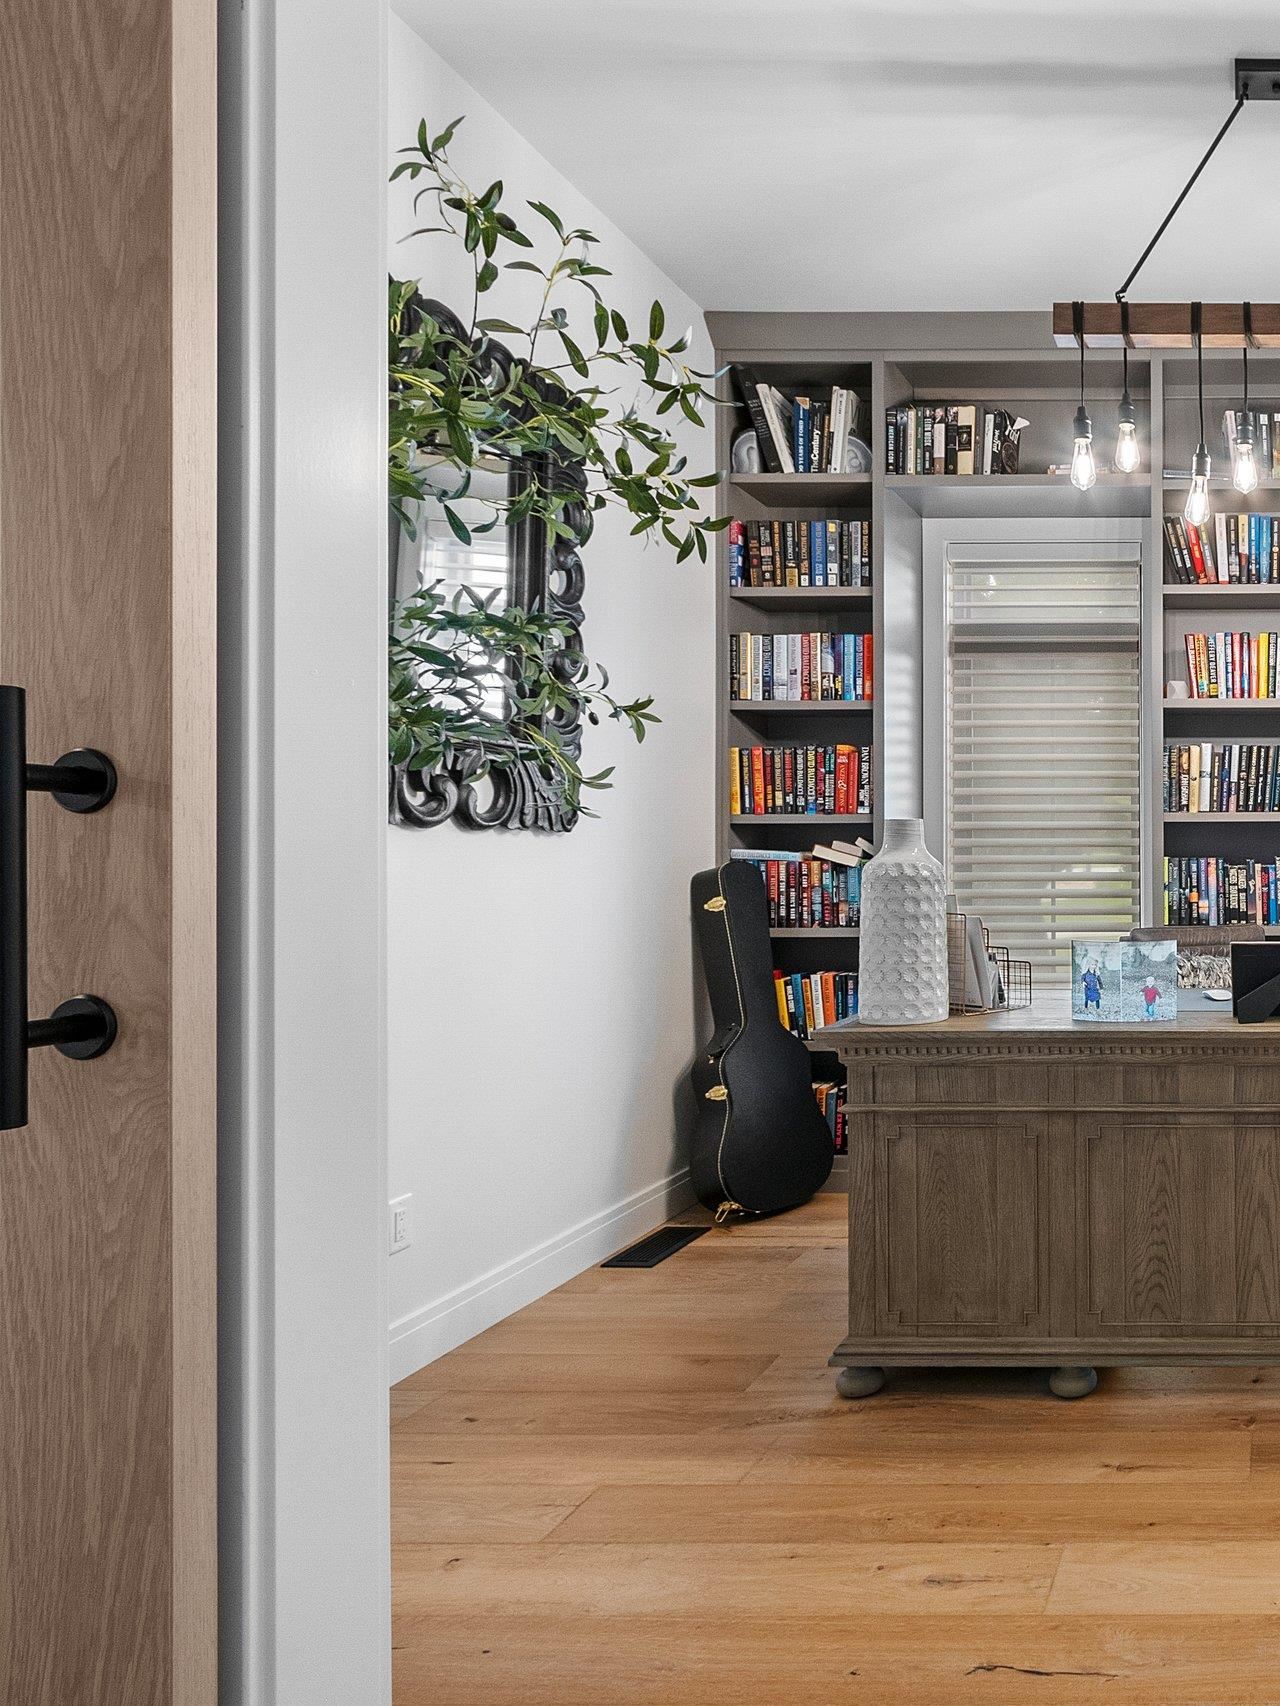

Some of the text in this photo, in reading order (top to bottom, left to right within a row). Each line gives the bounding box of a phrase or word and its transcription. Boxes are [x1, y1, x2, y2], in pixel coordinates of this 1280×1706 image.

[924, 418, 932, 431] ELON
[798, 437, 804, 445] OF
[924, 432, 932, 447] MUSK
[763, 636, 771, 676] DAVID BALDACCI
[802, 636, 810, 684] DAVID BALDACCI
[861, 747, 869, 761] DAN
[807, 751, 816, 795] DAVID BALDACCI
[861, 762, 869, 784] BROWN
